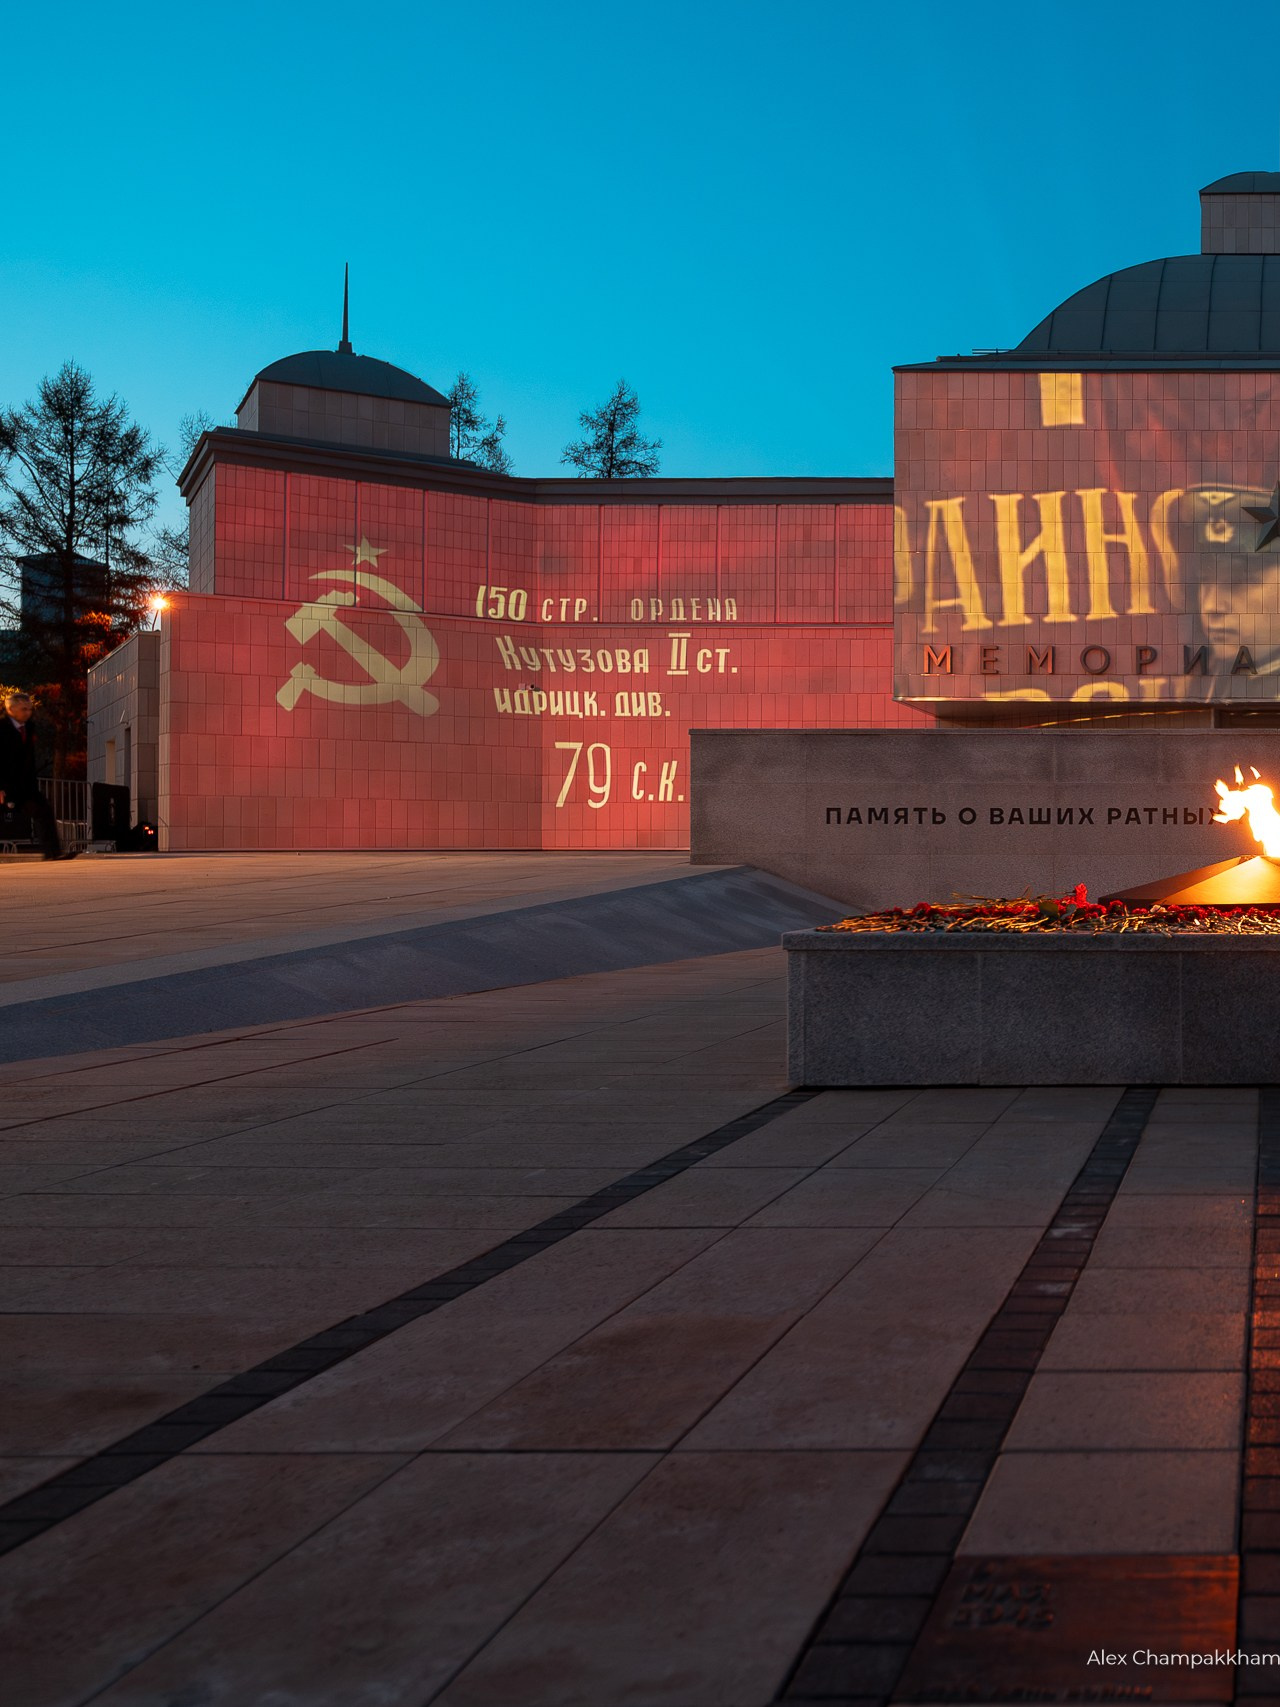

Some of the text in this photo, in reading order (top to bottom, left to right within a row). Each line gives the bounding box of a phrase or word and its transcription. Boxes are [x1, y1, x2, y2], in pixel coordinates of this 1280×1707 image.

[475, 585, 529, 621] 150
[630, 597, 739, 622] ОРДЕНА
[554, 741, 685, 809] 79 С.К.
[825, 806, 947, 826] ПАМЯТЬ
[958, 806, 978, 826] О
[989, 806, 1095, 826] ВАШИХ
[1106, 806, 1224, 826] РАТНЫХ
